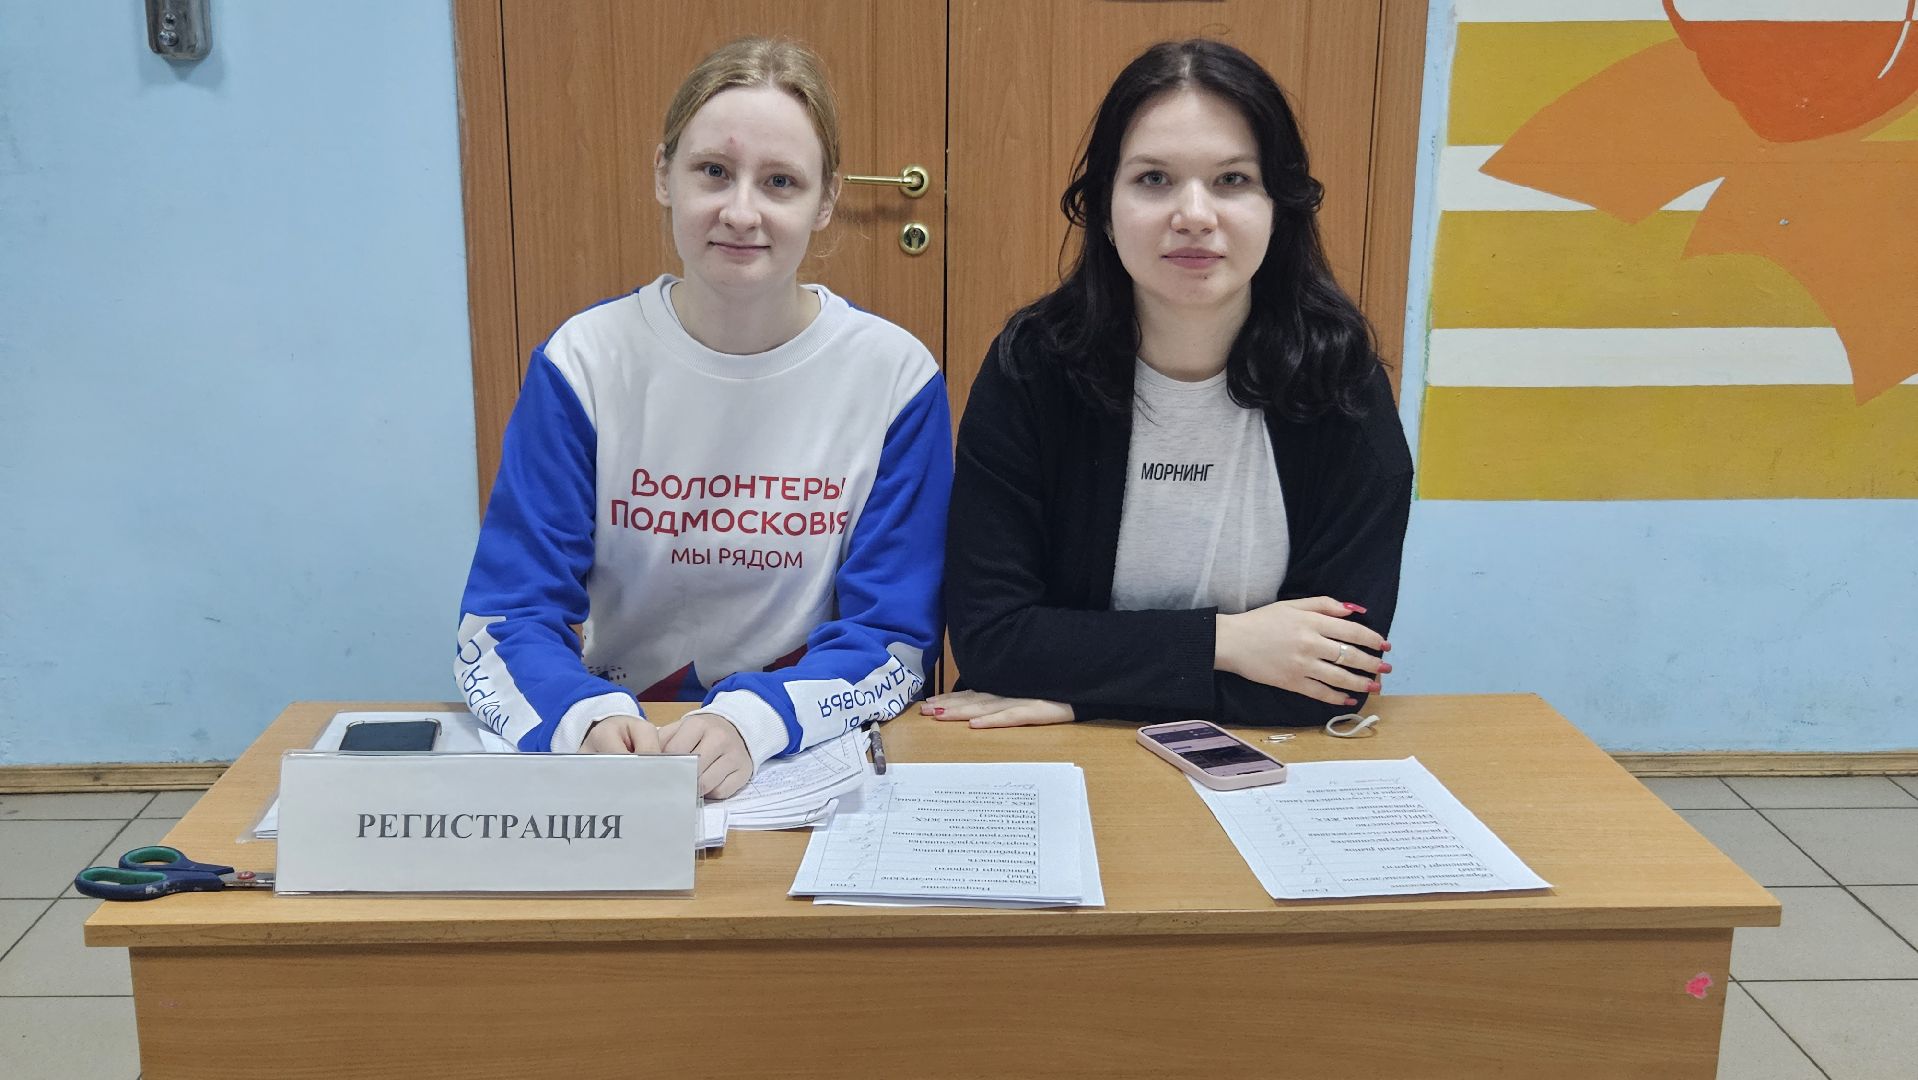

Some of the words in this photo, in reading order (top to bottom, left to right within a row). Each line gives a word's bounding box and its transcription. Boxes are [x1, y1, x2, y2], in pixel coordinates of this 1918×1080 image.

[1141, 463, 1214, 481] МОРНИНГ
[671, 548, 710, 565] МЫ
[719, 548, 803, 570] РЯДОМ
[356, 813, 623, 845] РЕГИСТРАЦИЯ
